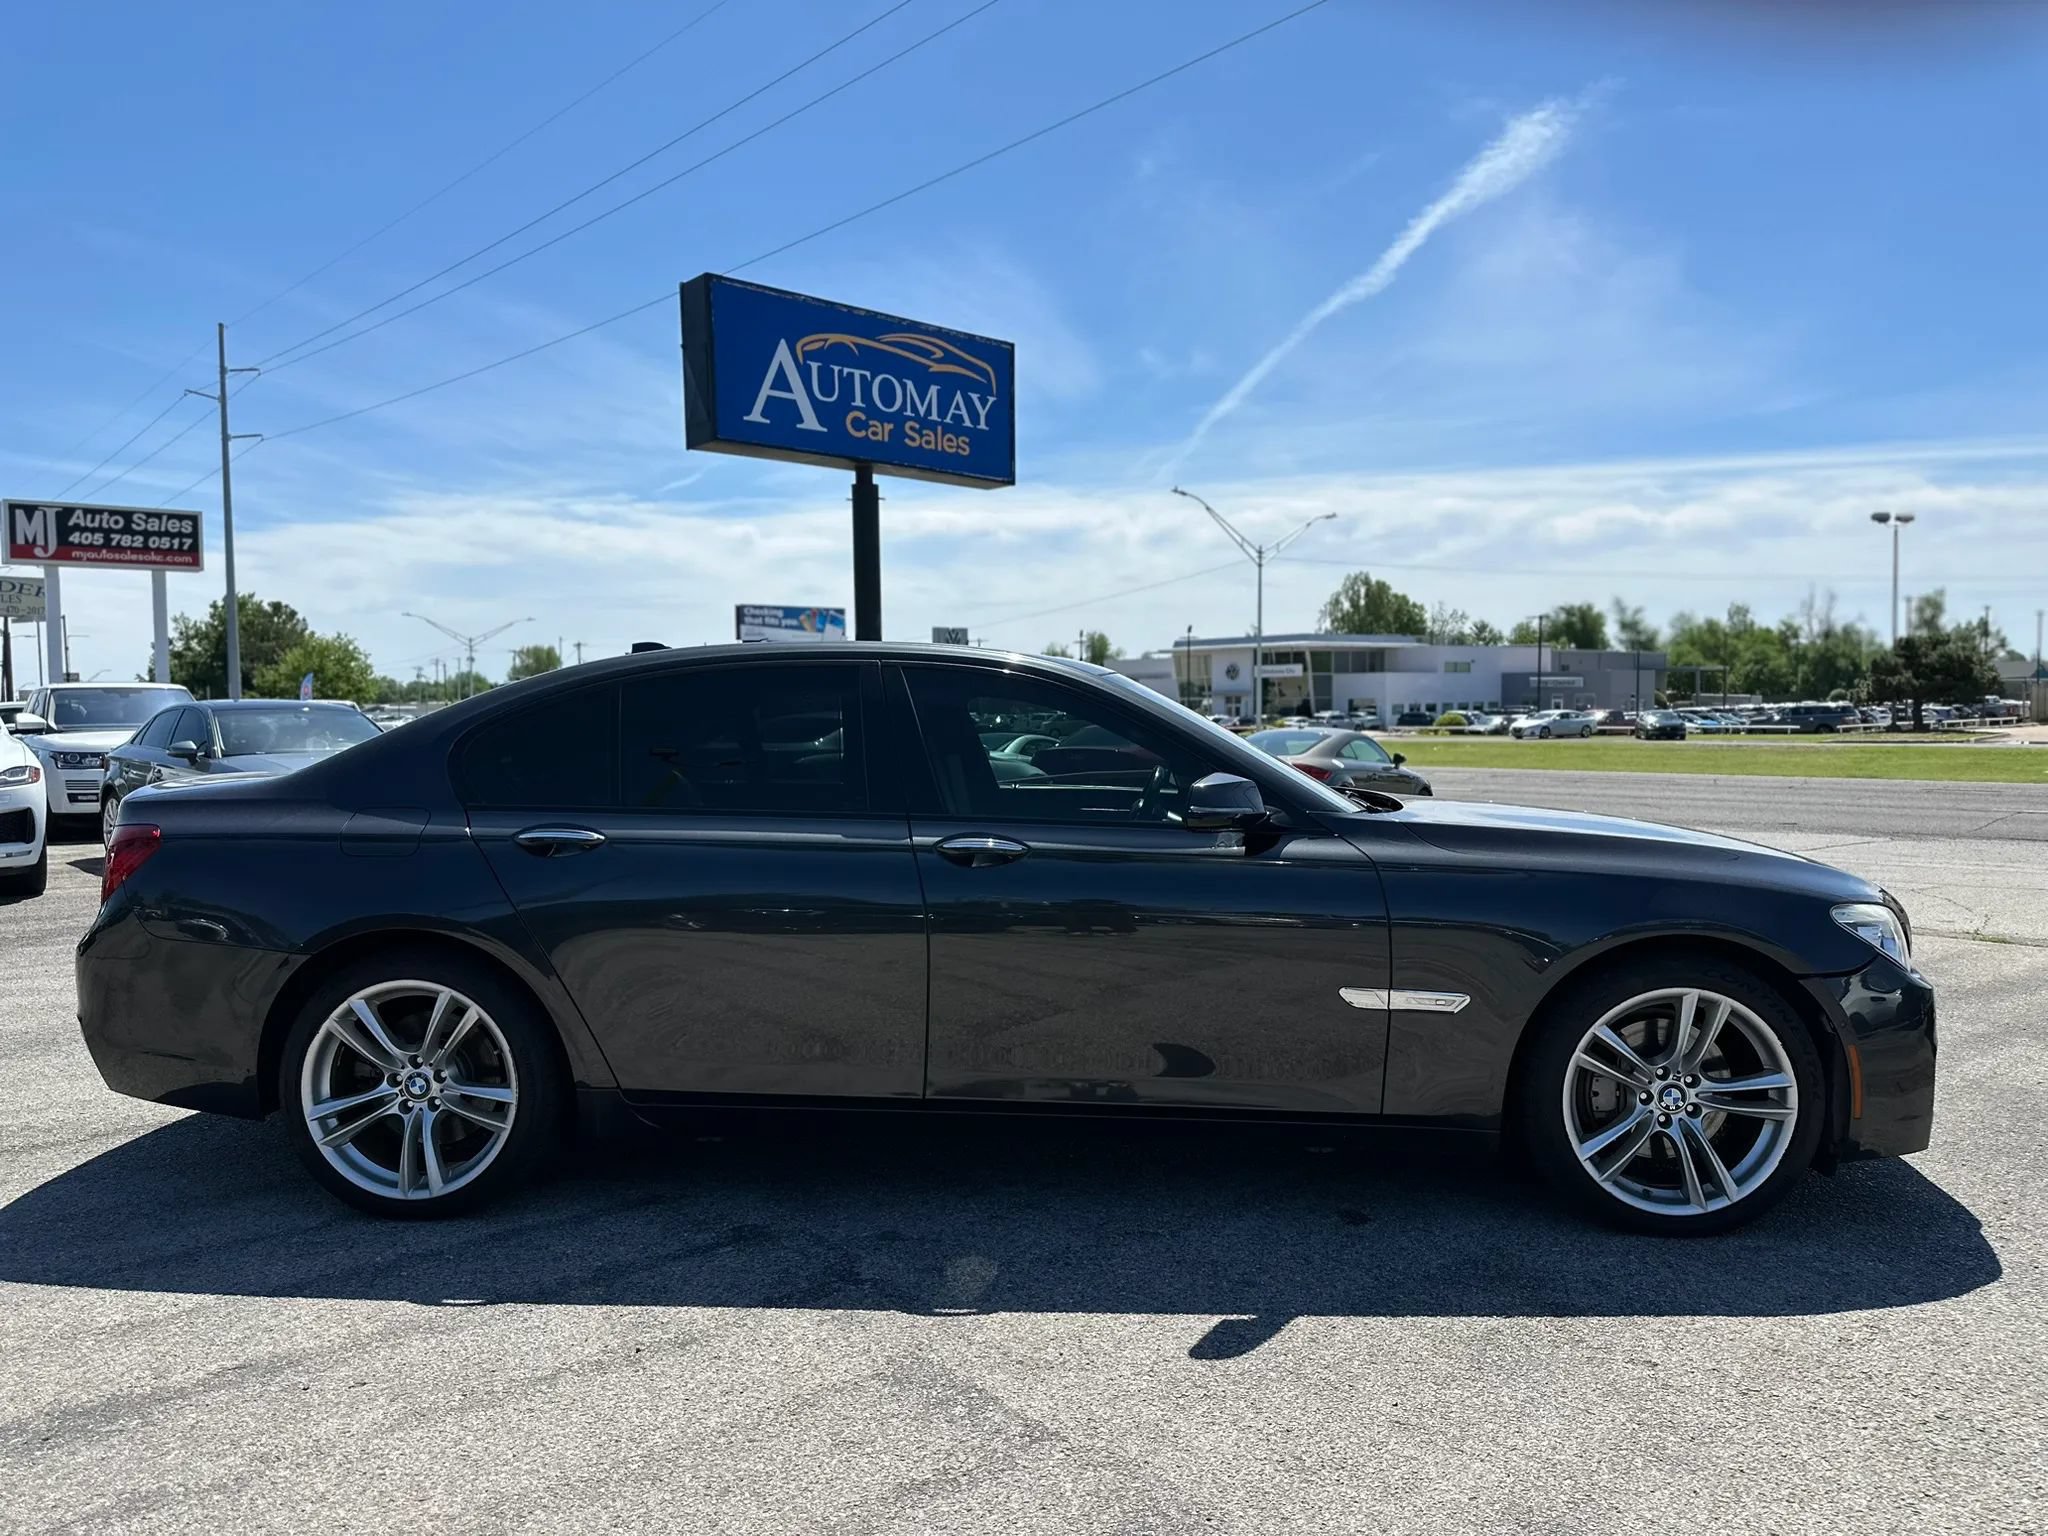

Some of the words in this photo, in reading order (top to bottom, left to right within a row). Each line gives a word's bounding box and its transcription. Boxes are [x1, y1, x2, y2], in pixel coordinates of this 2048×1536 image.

[743, 338, 997, 432] AUTOMAY
[845, 411, 893, 442] Car
[904, 422, 970, 456] Sales
[68, 509, 124, 529] Auto
[131, 513, 193, 534] Sales
[15, 507, 62, 558] MJ
[68, 532, 104, 545] 405
[109, 534, 144, 548] 782
[148, 536, 193, 550] 0517
[72, 549, 193, 564] mjautosalesokc.com
[744, 607, 784, 617] Checking
[744, 616, 763, 625] that
[765, 617, 779, 625] fits
